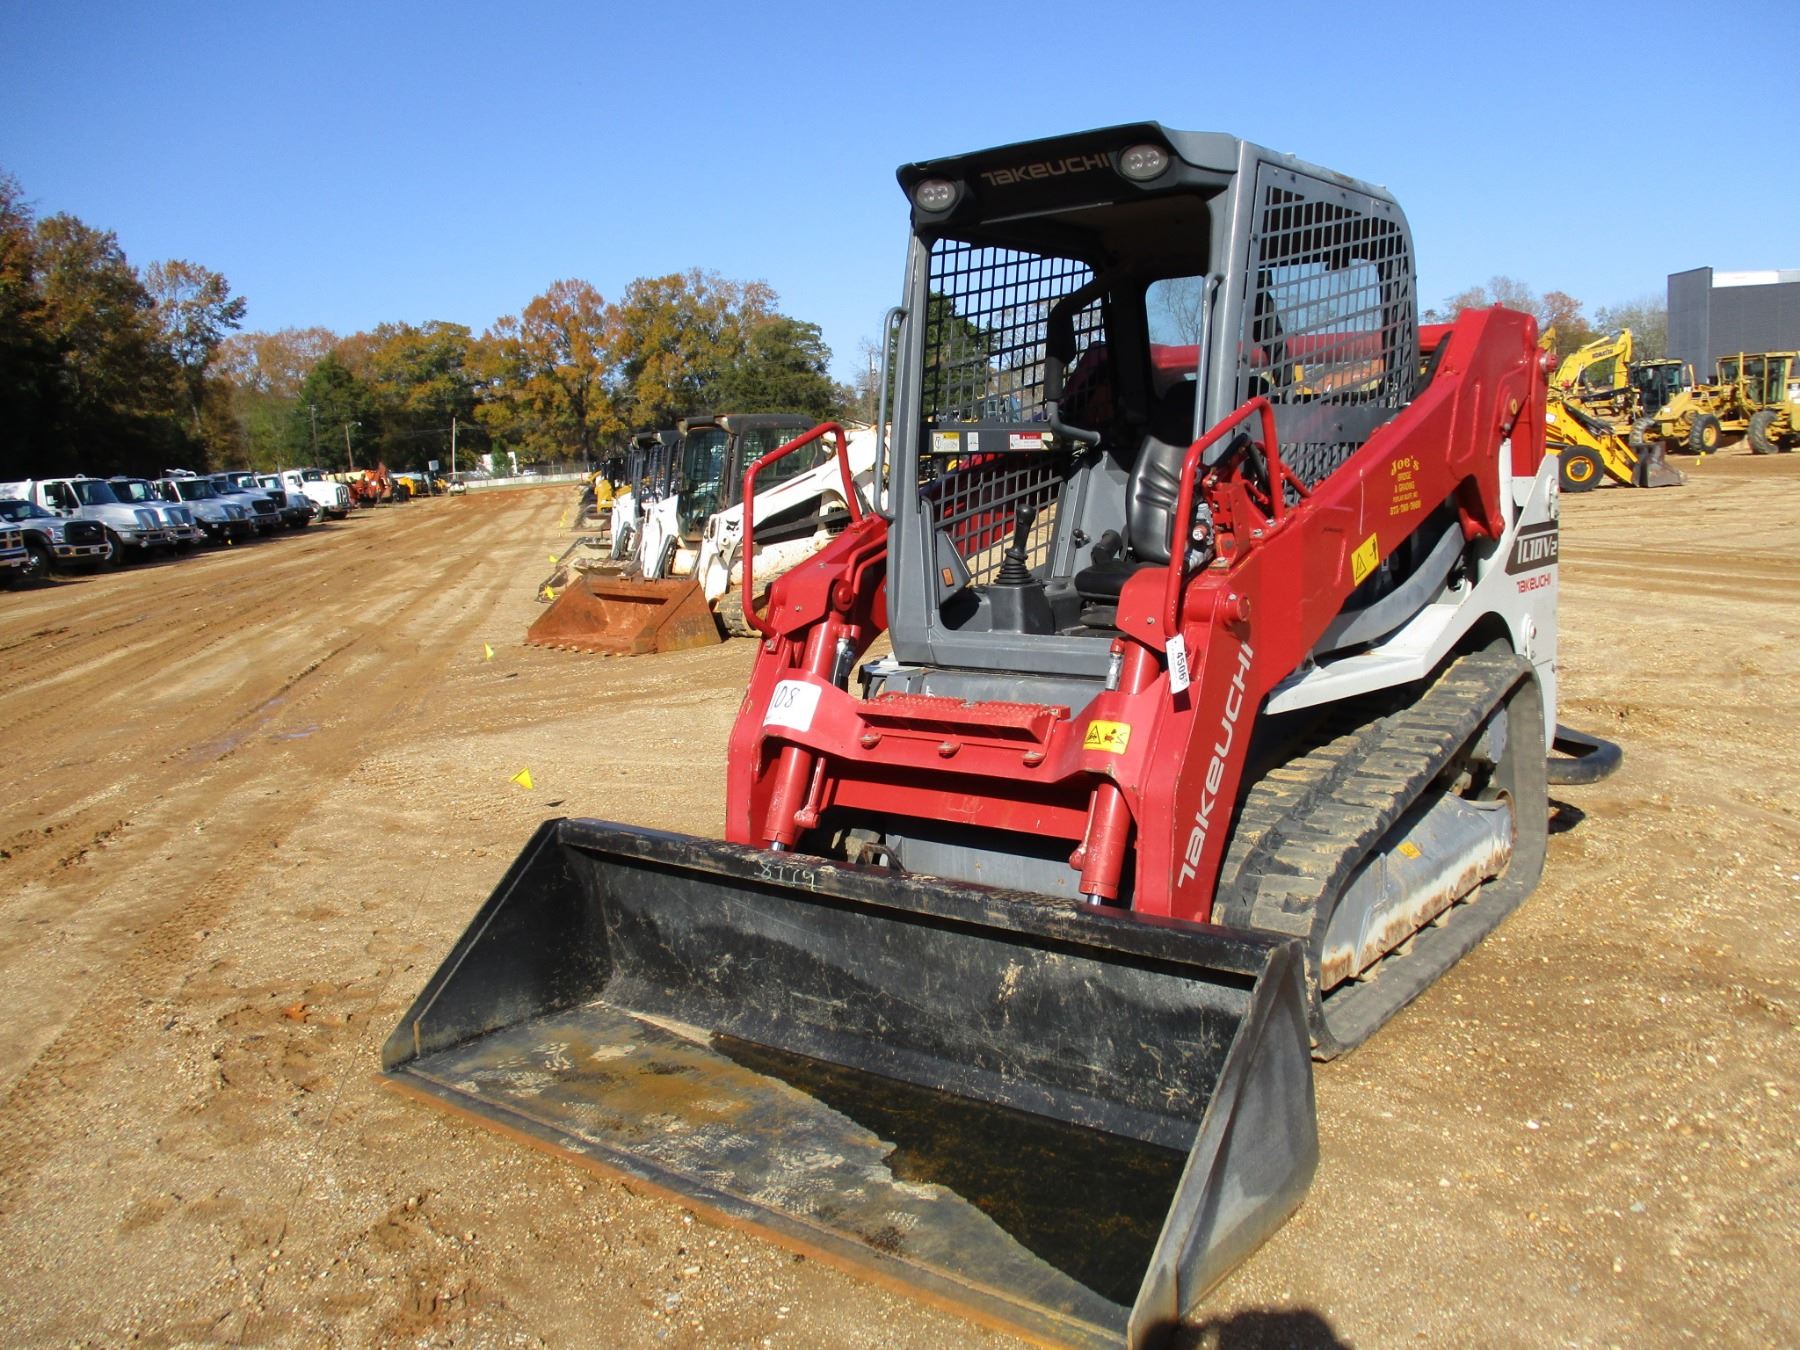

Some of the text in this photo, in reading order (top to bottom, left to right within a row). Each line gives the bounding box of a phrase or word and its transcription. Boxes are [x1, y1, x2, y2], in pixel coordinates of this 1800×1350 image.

[980, 153, 1110, 186] TAKEUCHI
[1391, 455, 1420, 476] Joe's
[1517, 573, 1552, 594] TAKEUCHI
[1177, 640, 1254, 888] TAKEUCHI
